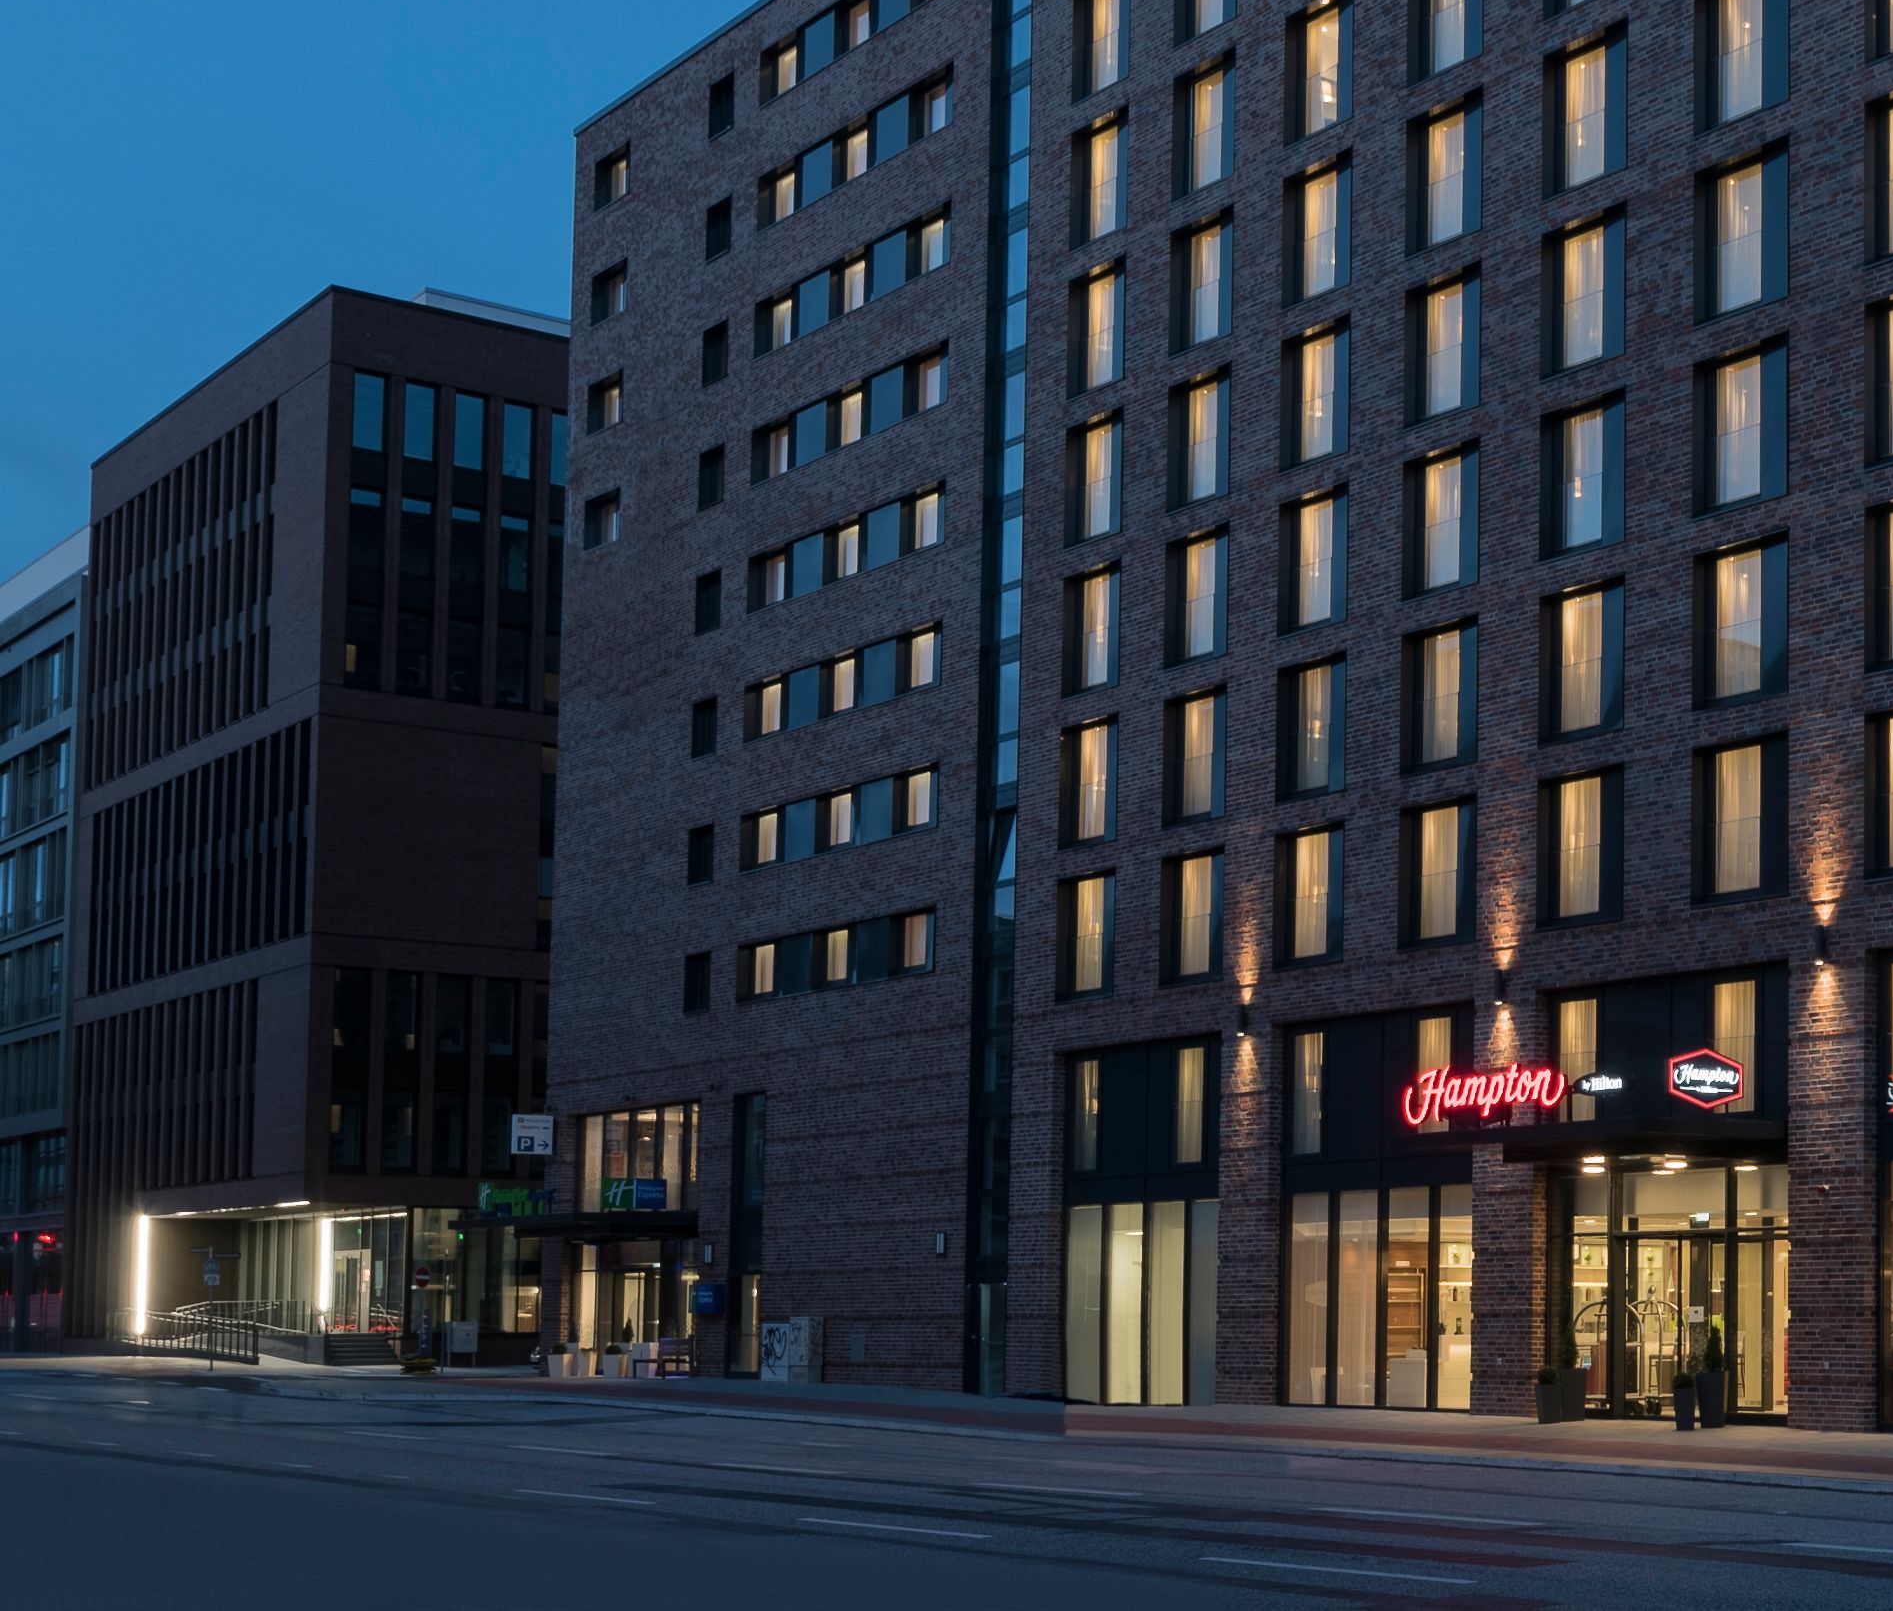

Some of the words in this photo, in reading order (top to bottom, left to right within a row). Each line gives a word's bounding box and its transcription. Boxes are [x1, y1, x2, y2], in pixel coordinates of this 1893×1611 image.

[1589, 1074, 1623, 1091] Hilton
[1673, 1063, 1740, 1086] Hampton
[1405, 1063, 1565, 1125] Hampton
[520, 1138, 531, 1150] P
